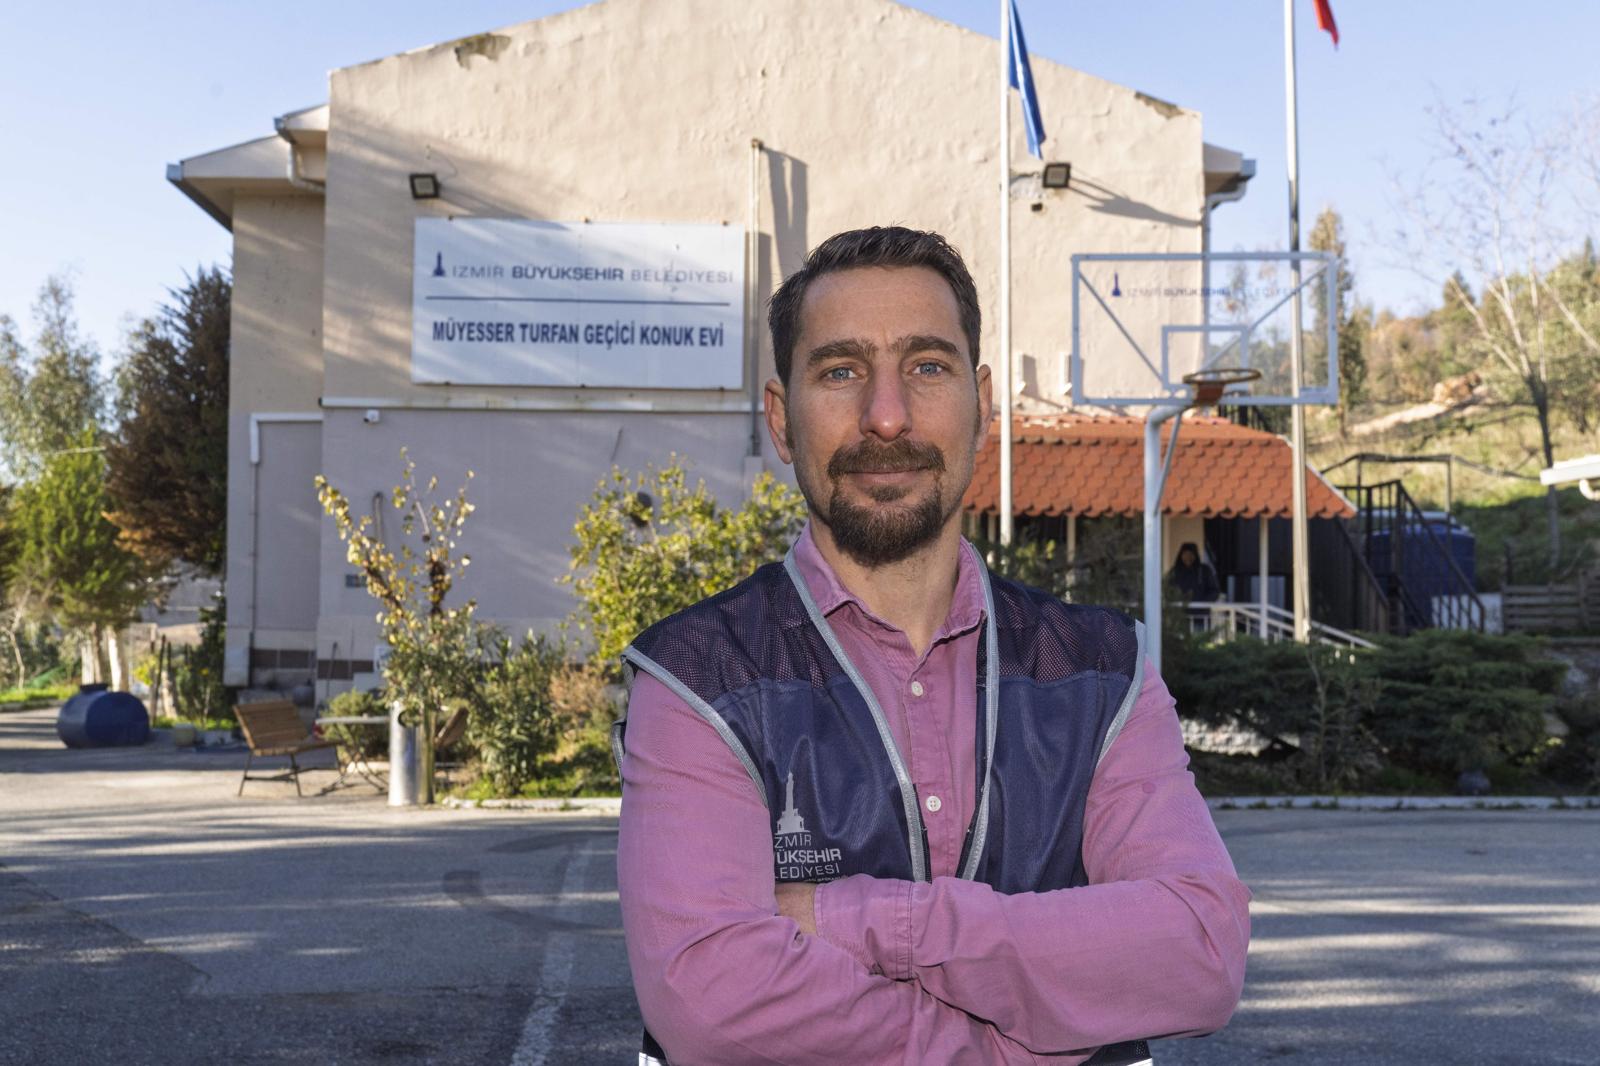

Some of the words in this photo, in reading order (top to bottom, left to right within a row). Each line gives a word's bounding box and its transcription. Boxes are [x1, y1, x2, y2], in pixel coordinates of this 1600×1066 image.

[432, 316, 515, 342] MÜYESSER
[519, 322, 580, 344] TURFAN
[583, 319, 636, 350] GEÇİCİ
[639, 324, 695, 347] KONUK
[698, 322, 724, 347] EVİ
[774, 833, 811, 848] ZMİR
